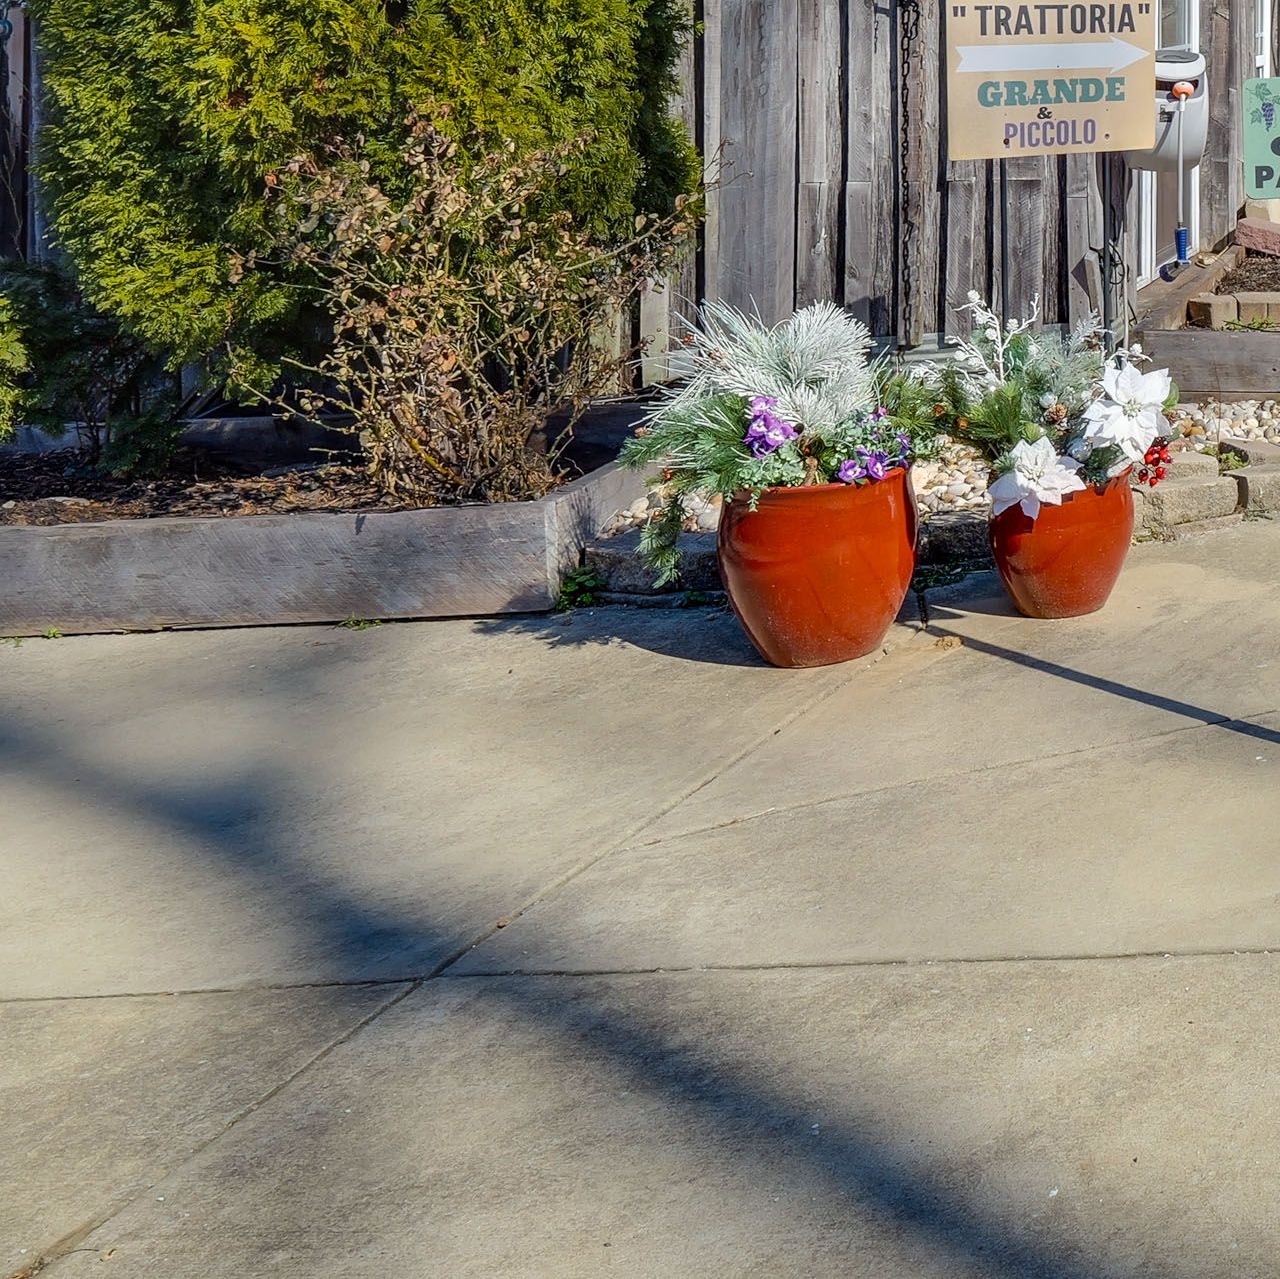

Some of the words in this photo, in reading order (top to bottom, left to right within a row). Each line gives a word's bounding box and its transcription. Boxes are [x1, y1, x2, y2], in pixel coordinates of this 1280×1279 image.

[977, 77, 1125, 107] GRANDE
[1037, 106, 1052, 119] &
[1004, 119, 1096, 149] PICCOLO
